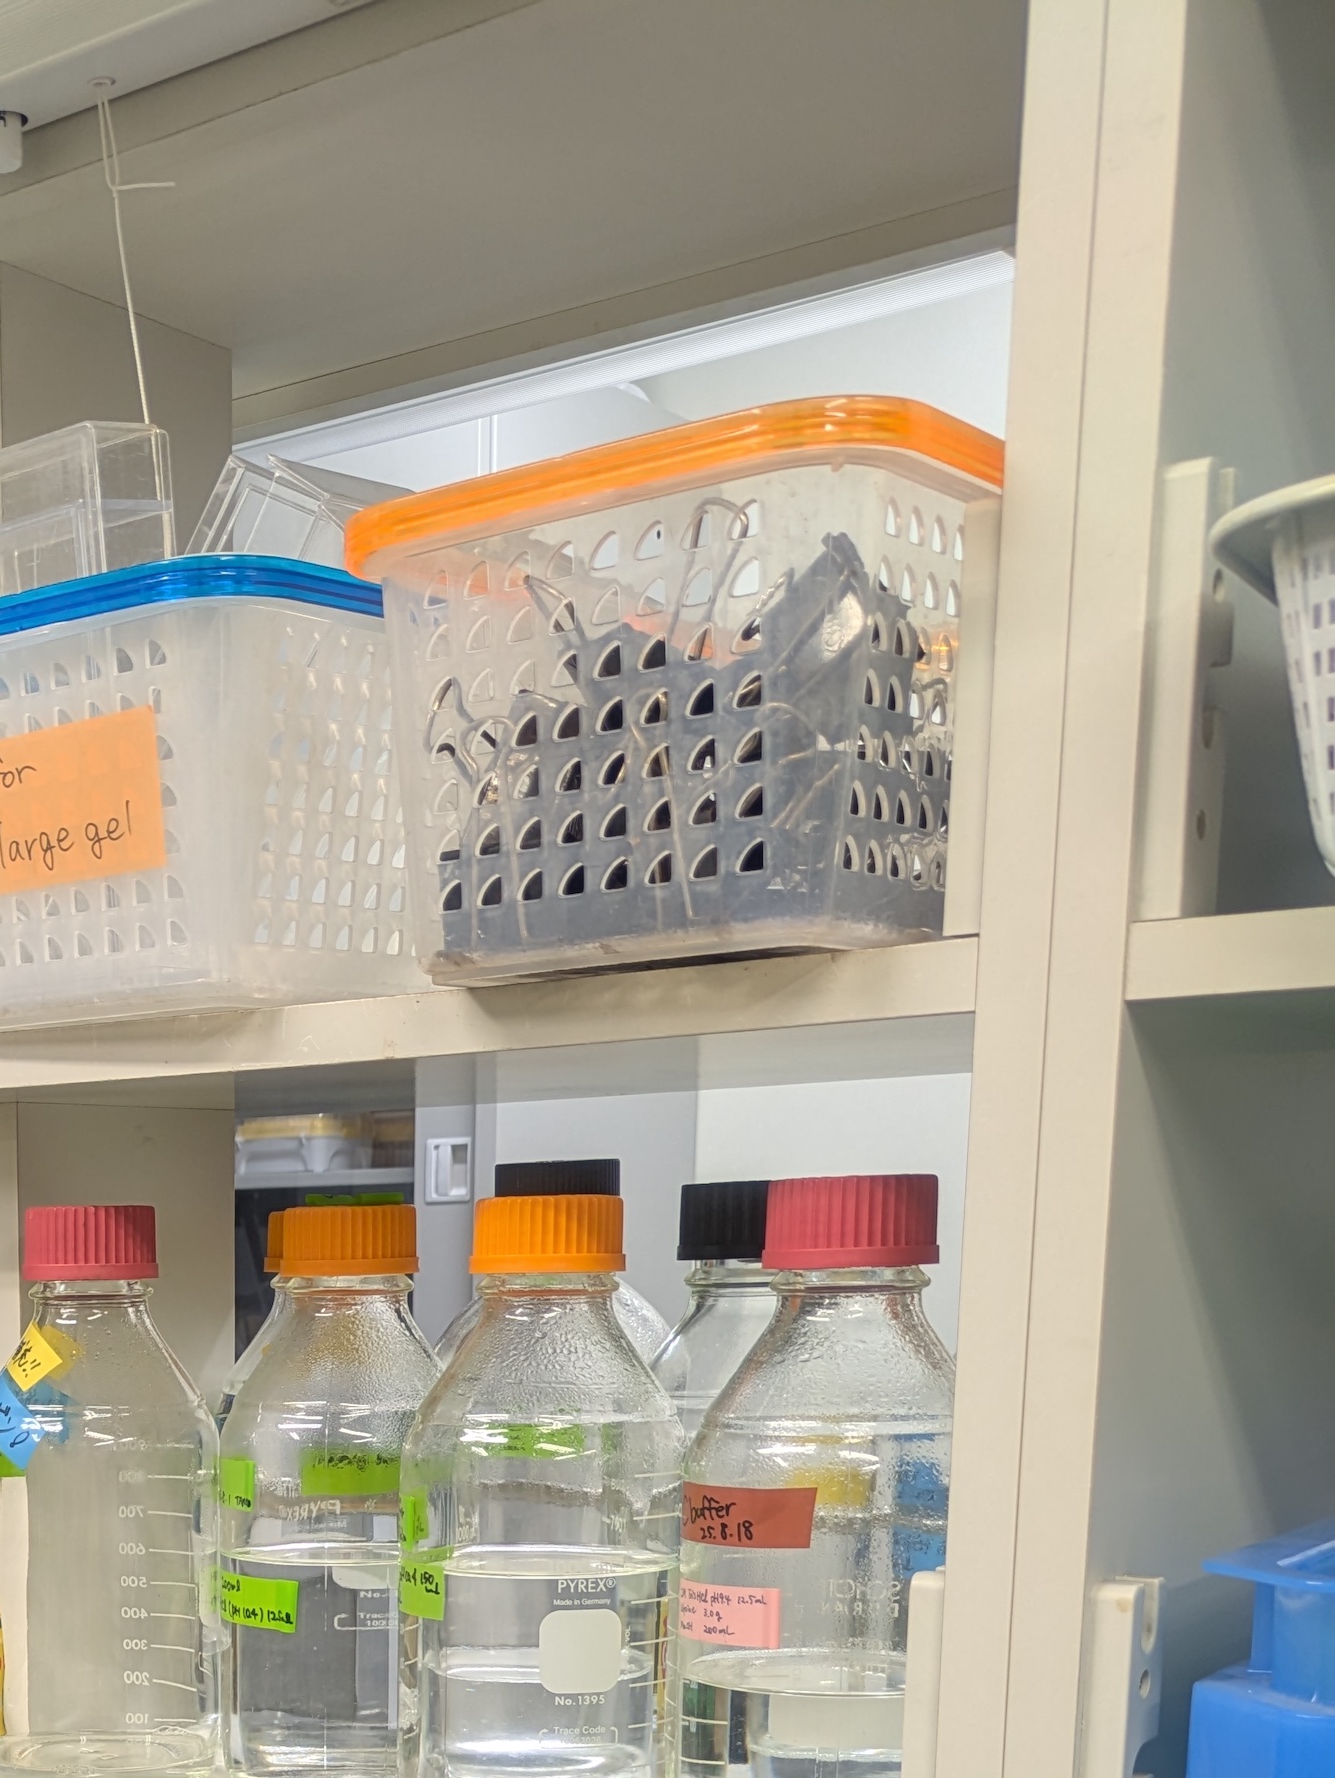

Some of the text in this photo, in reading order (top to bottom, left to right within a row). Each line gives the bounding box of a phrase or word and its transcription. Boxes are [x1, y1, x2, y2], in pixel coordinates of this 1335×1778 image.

[85, 799, 132, 860] gel
[690, 1494, 737, 1525] buffer
[700, 1520, 754, 1542] 25.8.18
[553, 1598, 612, 1607] Made in Germany
[554, 1694, 606, 1706] No.1395
[553, 1725, 606, 1736] Trace Code
